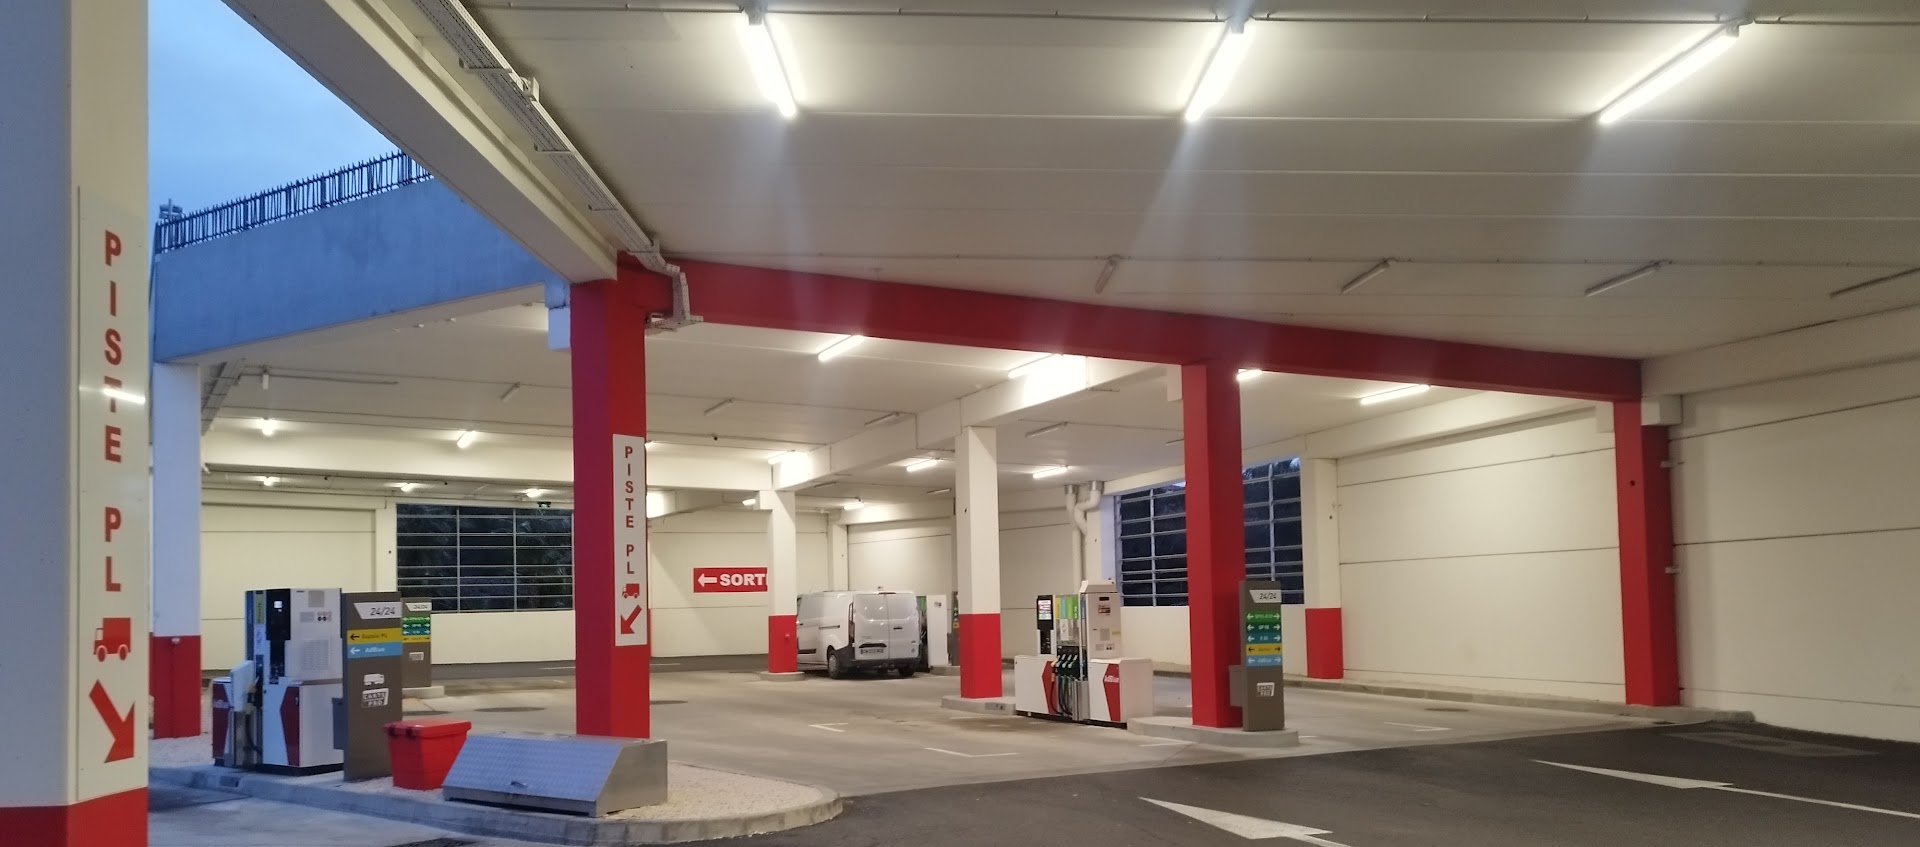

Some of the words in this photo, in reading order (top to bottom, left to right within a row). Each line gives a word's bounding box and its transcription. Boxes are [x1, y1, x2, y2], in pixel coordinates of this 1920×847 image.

[104, 229, 122, 463] PISTE
[625, 446, 634, 529] PISTE
[104, 506, 122, 592] PL
[626, 544, 635, 575] PL
[370, 607, 396, 616] 24/24
[1259, 592, 1277, 600] 24/24
